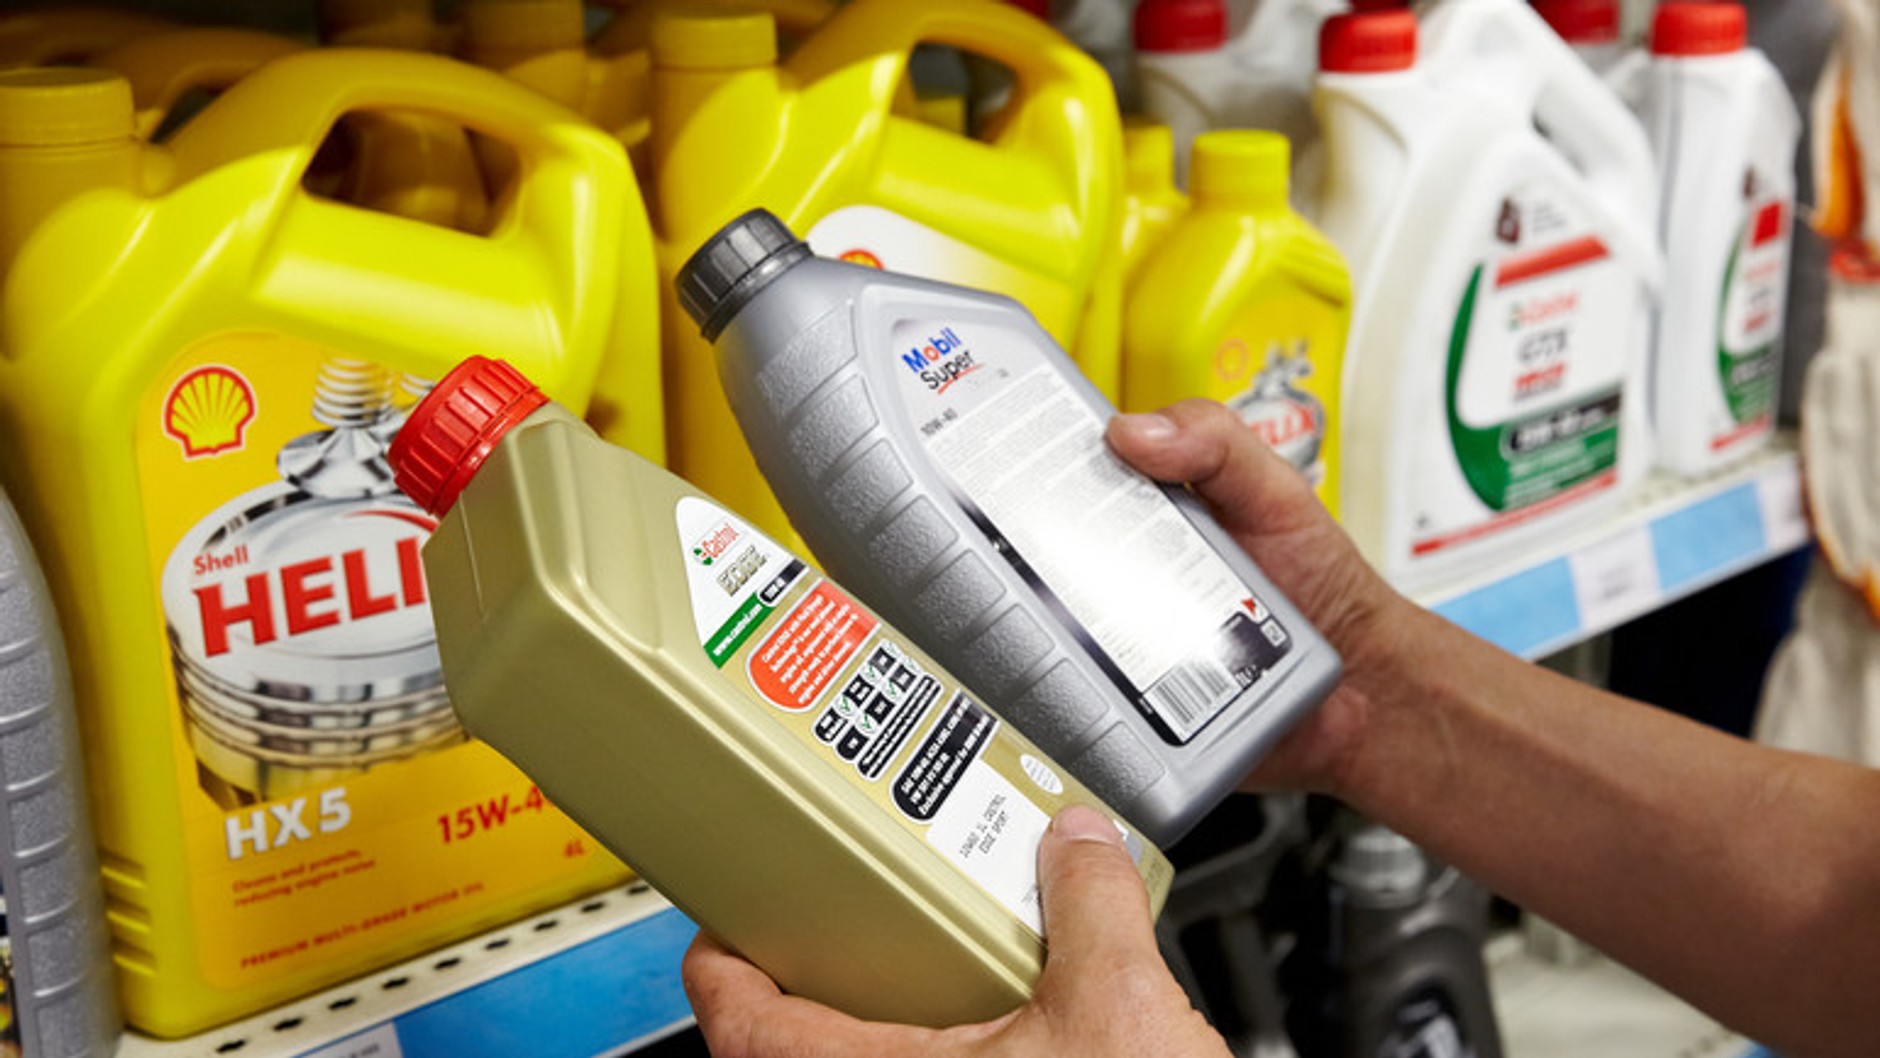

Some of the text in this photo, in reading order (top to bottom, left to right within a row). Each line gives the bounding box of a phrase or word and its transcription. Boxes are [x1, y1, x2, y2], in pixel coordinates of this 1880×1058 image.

[901, 327, 962, 373] Mobil
[920, 350, 974, 391] Super
[193, 544, 249, 576] Shell
[701, 522, 740, 559] Castrol
[192, 536, 426, 658] HELI
[437, 784, 554, 845] 15W-4
[234, 858, 376, 907] reducing engine noise
[282, 866, 305, 882] and
[240, 940, 309, 970] PREMIUM
[412, 888, 458, 914] MOTOR
